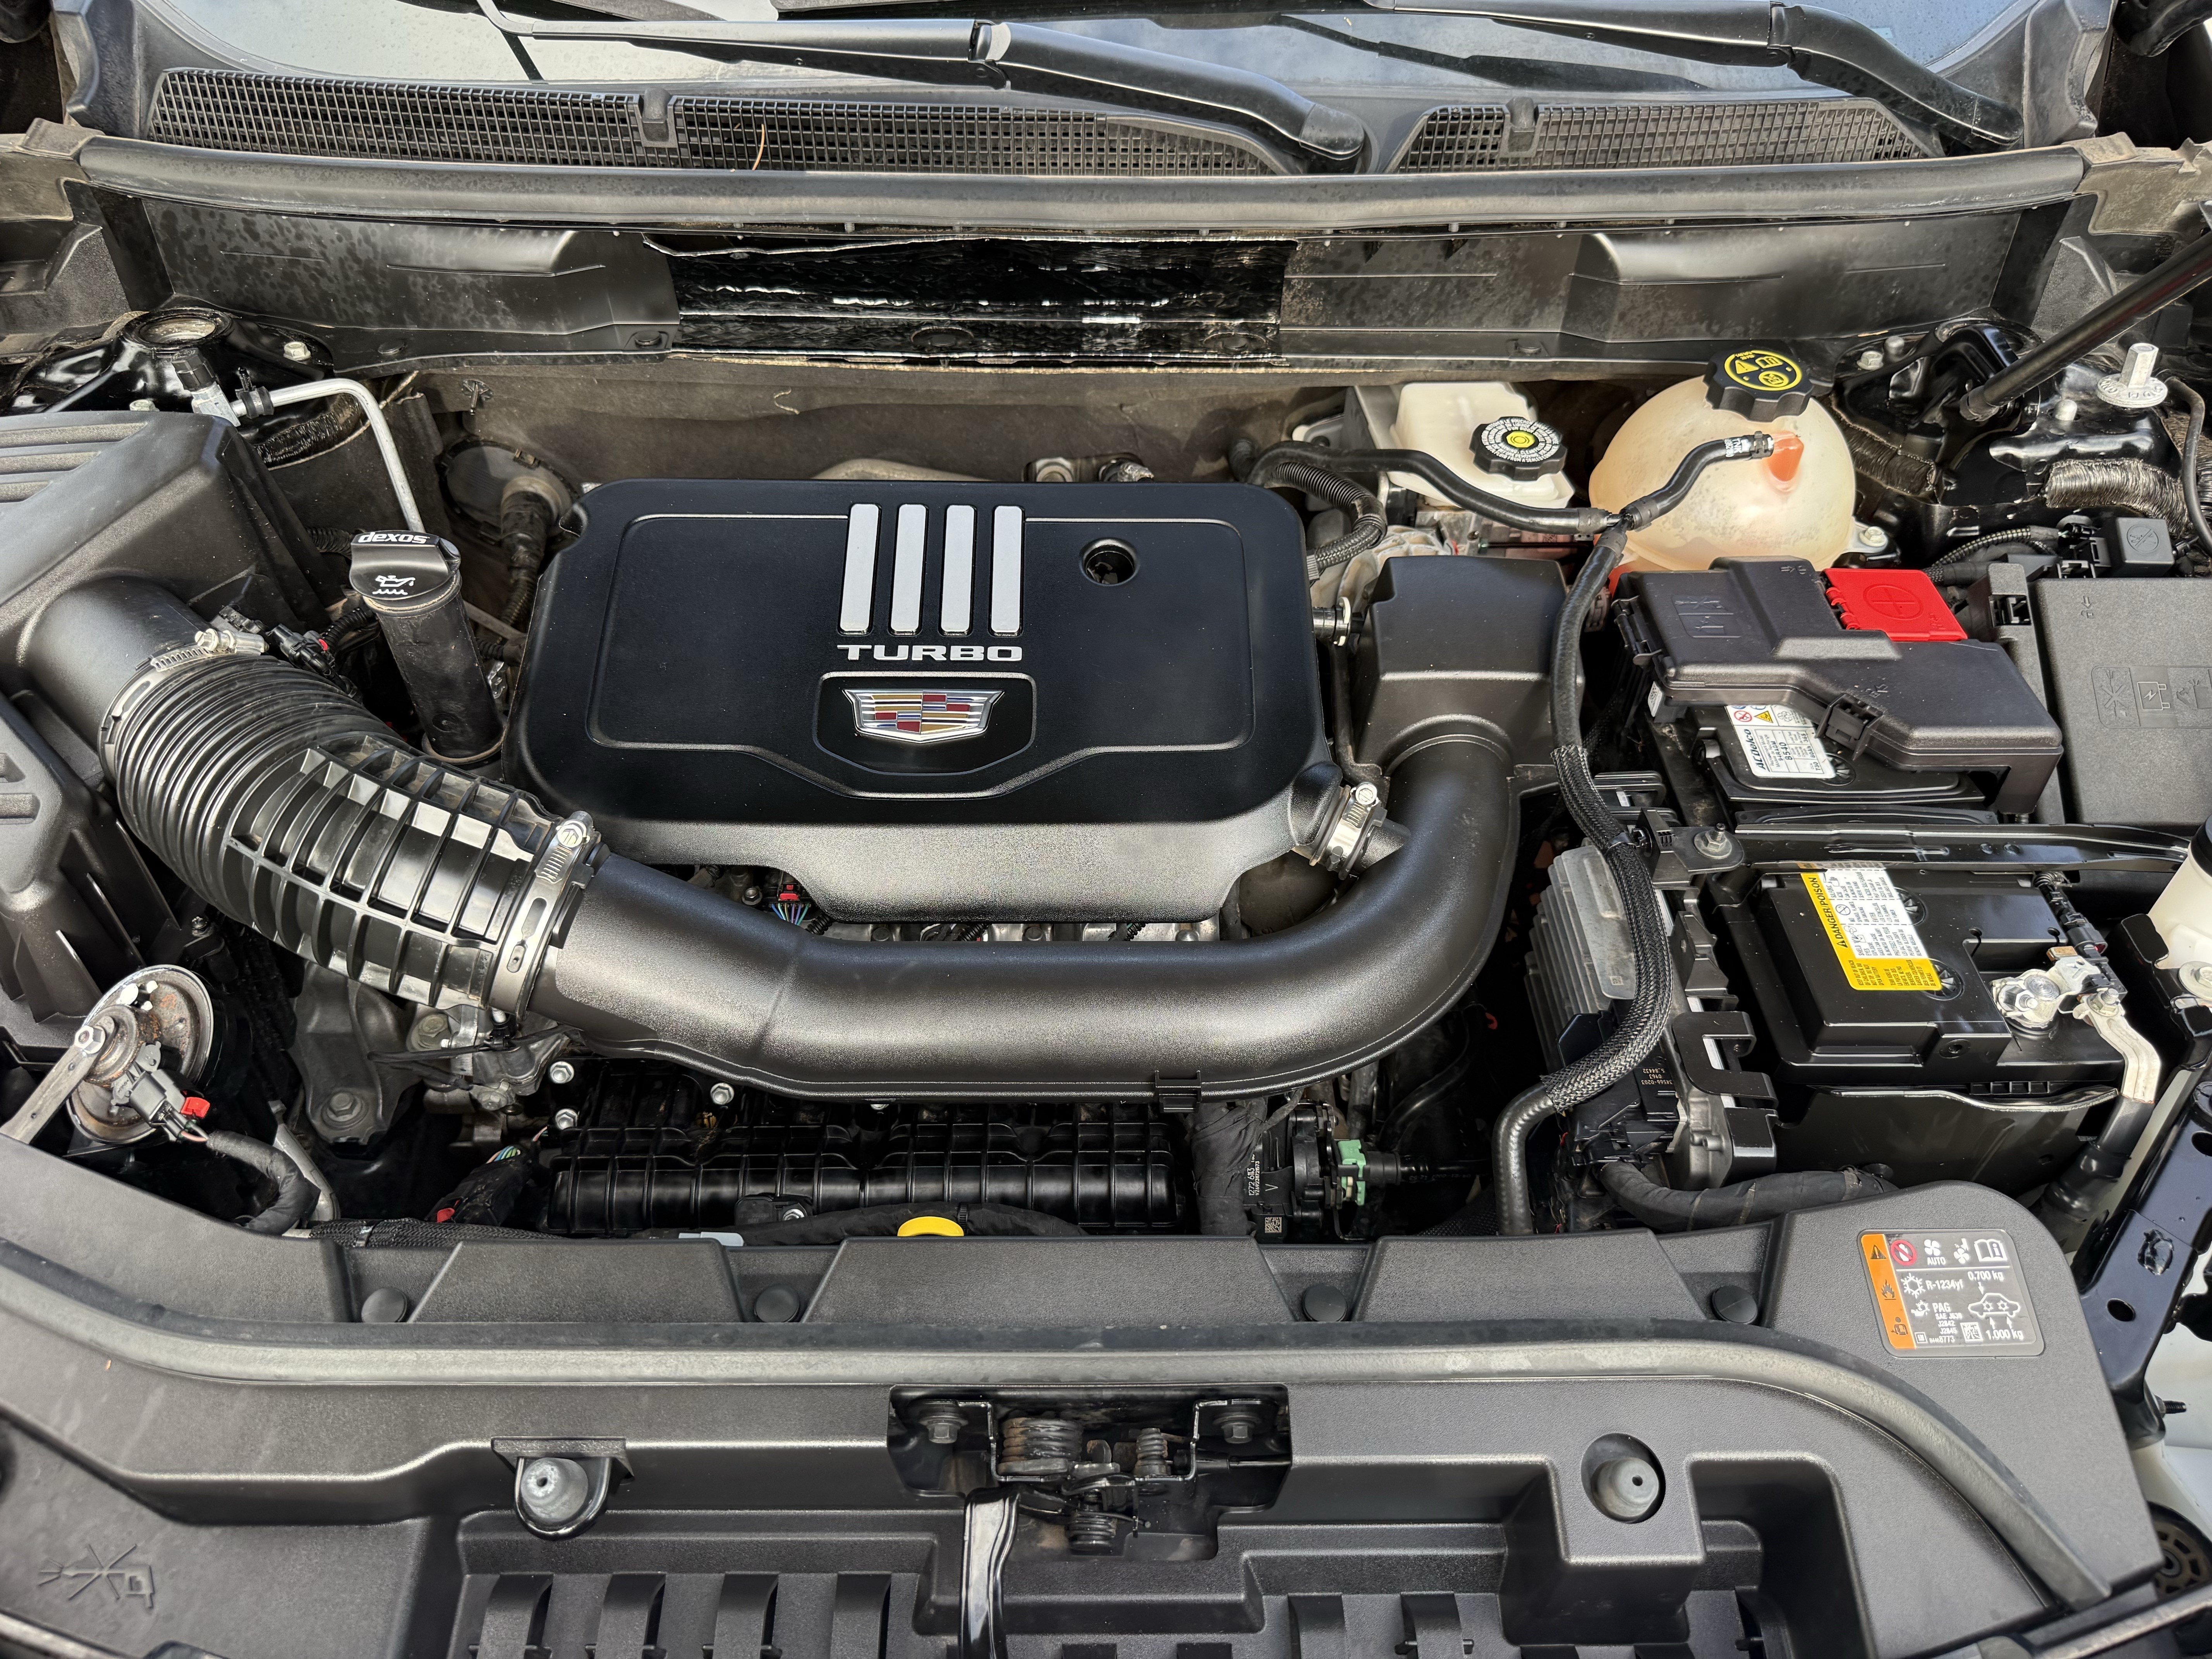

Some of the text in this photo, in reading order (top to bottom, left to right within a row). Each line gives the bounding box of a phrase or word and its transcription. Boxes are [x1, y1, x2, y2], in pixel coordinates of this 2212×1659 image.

[358, 532, 428, 544] dexos
[838, 645, 1021, 661] TURBO
[1743, 729, 1766, 770] ACDelco
[1779, 742, 1793, 760] 8540
[1805, 745, 1815, 758] 80Ah
[1808, 877, 1844, 939] DANGER/POISON
[1848, 960, 1856, 968] REACH
[1870, 966, 1881, 978] BATTERY
[1247, 1167, 1255, 1180] 6113
[1927, 1257, 1946, 1265] AUTO
[1967, 1270, 2005, 1282] 0.700 kg
[1925, 1279, 1964, 1292] R-1234yf
[1932, 1302, 1951, 1313] PAG
[1985, 1329, 2024, 1340] 1.000 kg
